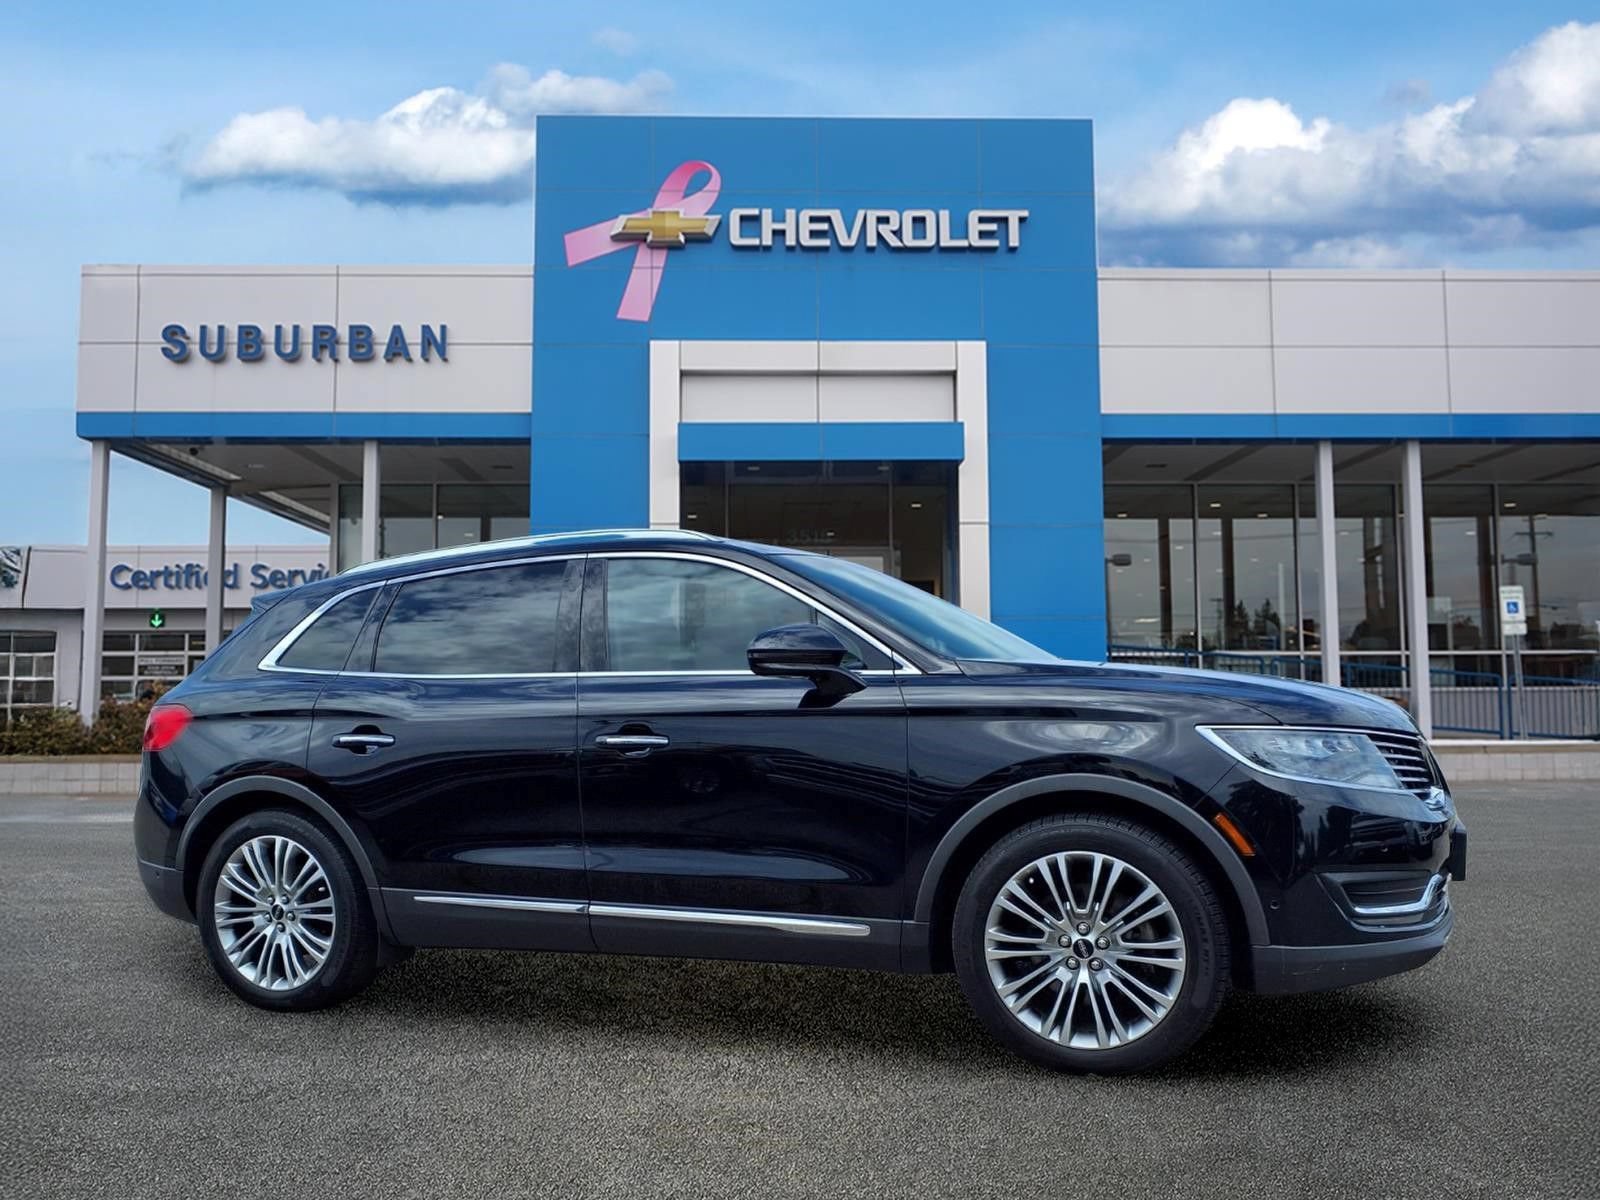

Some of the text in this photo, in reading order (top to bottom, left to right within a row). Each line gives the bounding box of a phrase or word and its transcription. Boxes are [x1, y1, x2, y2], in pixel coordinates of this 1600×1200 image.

[728, 207, 1029, 249] CHEVROLET
[161, 324, 449, 363] SUBURBAN
[250, 563, 331, 589] Servi
